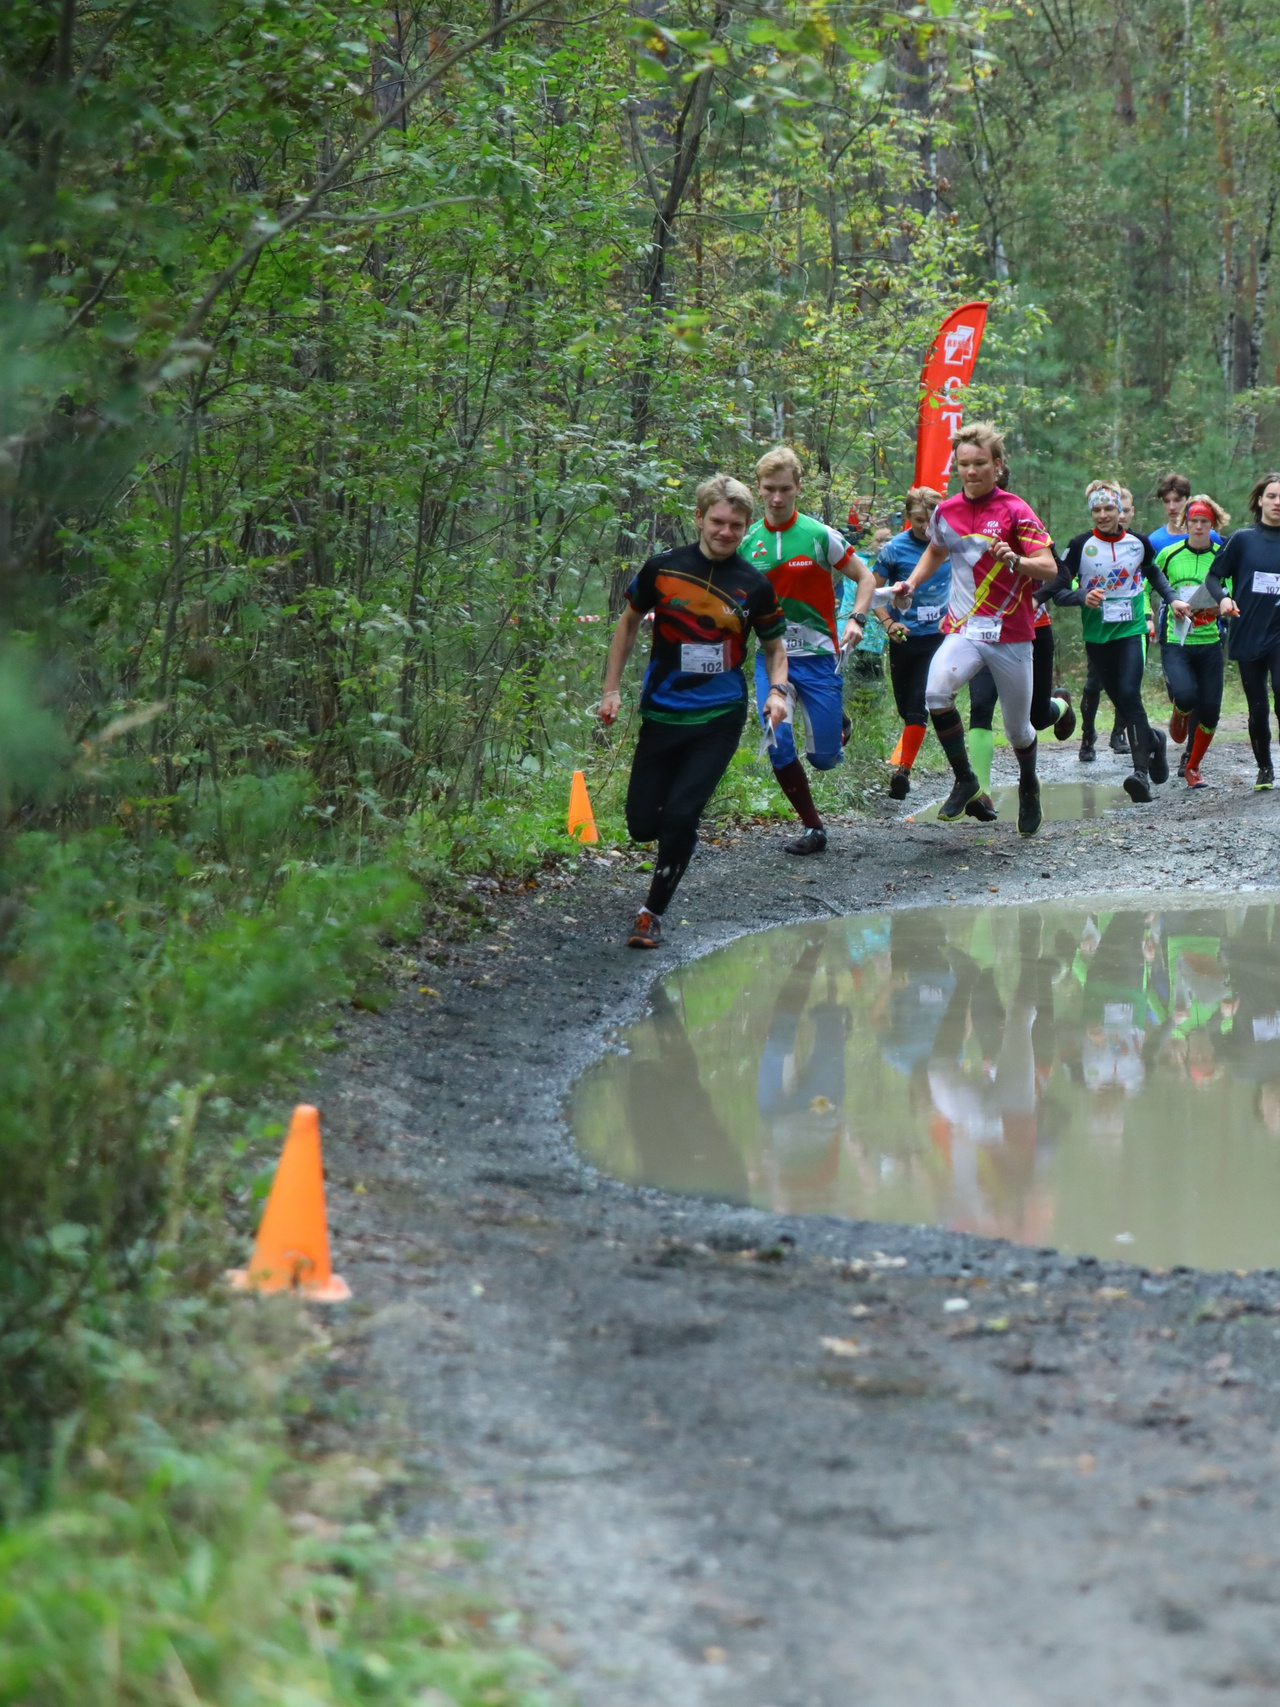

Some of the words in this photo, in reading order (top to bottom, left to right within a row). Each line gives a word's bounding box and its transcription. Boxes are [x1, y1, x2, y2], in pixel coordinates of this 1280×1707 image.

[1266, 585, 1280, 595] 107
[1119, 612, 1131, 621] 111
[786, 638, 802, 648] 101
[701, 661, 722, 673] 102
